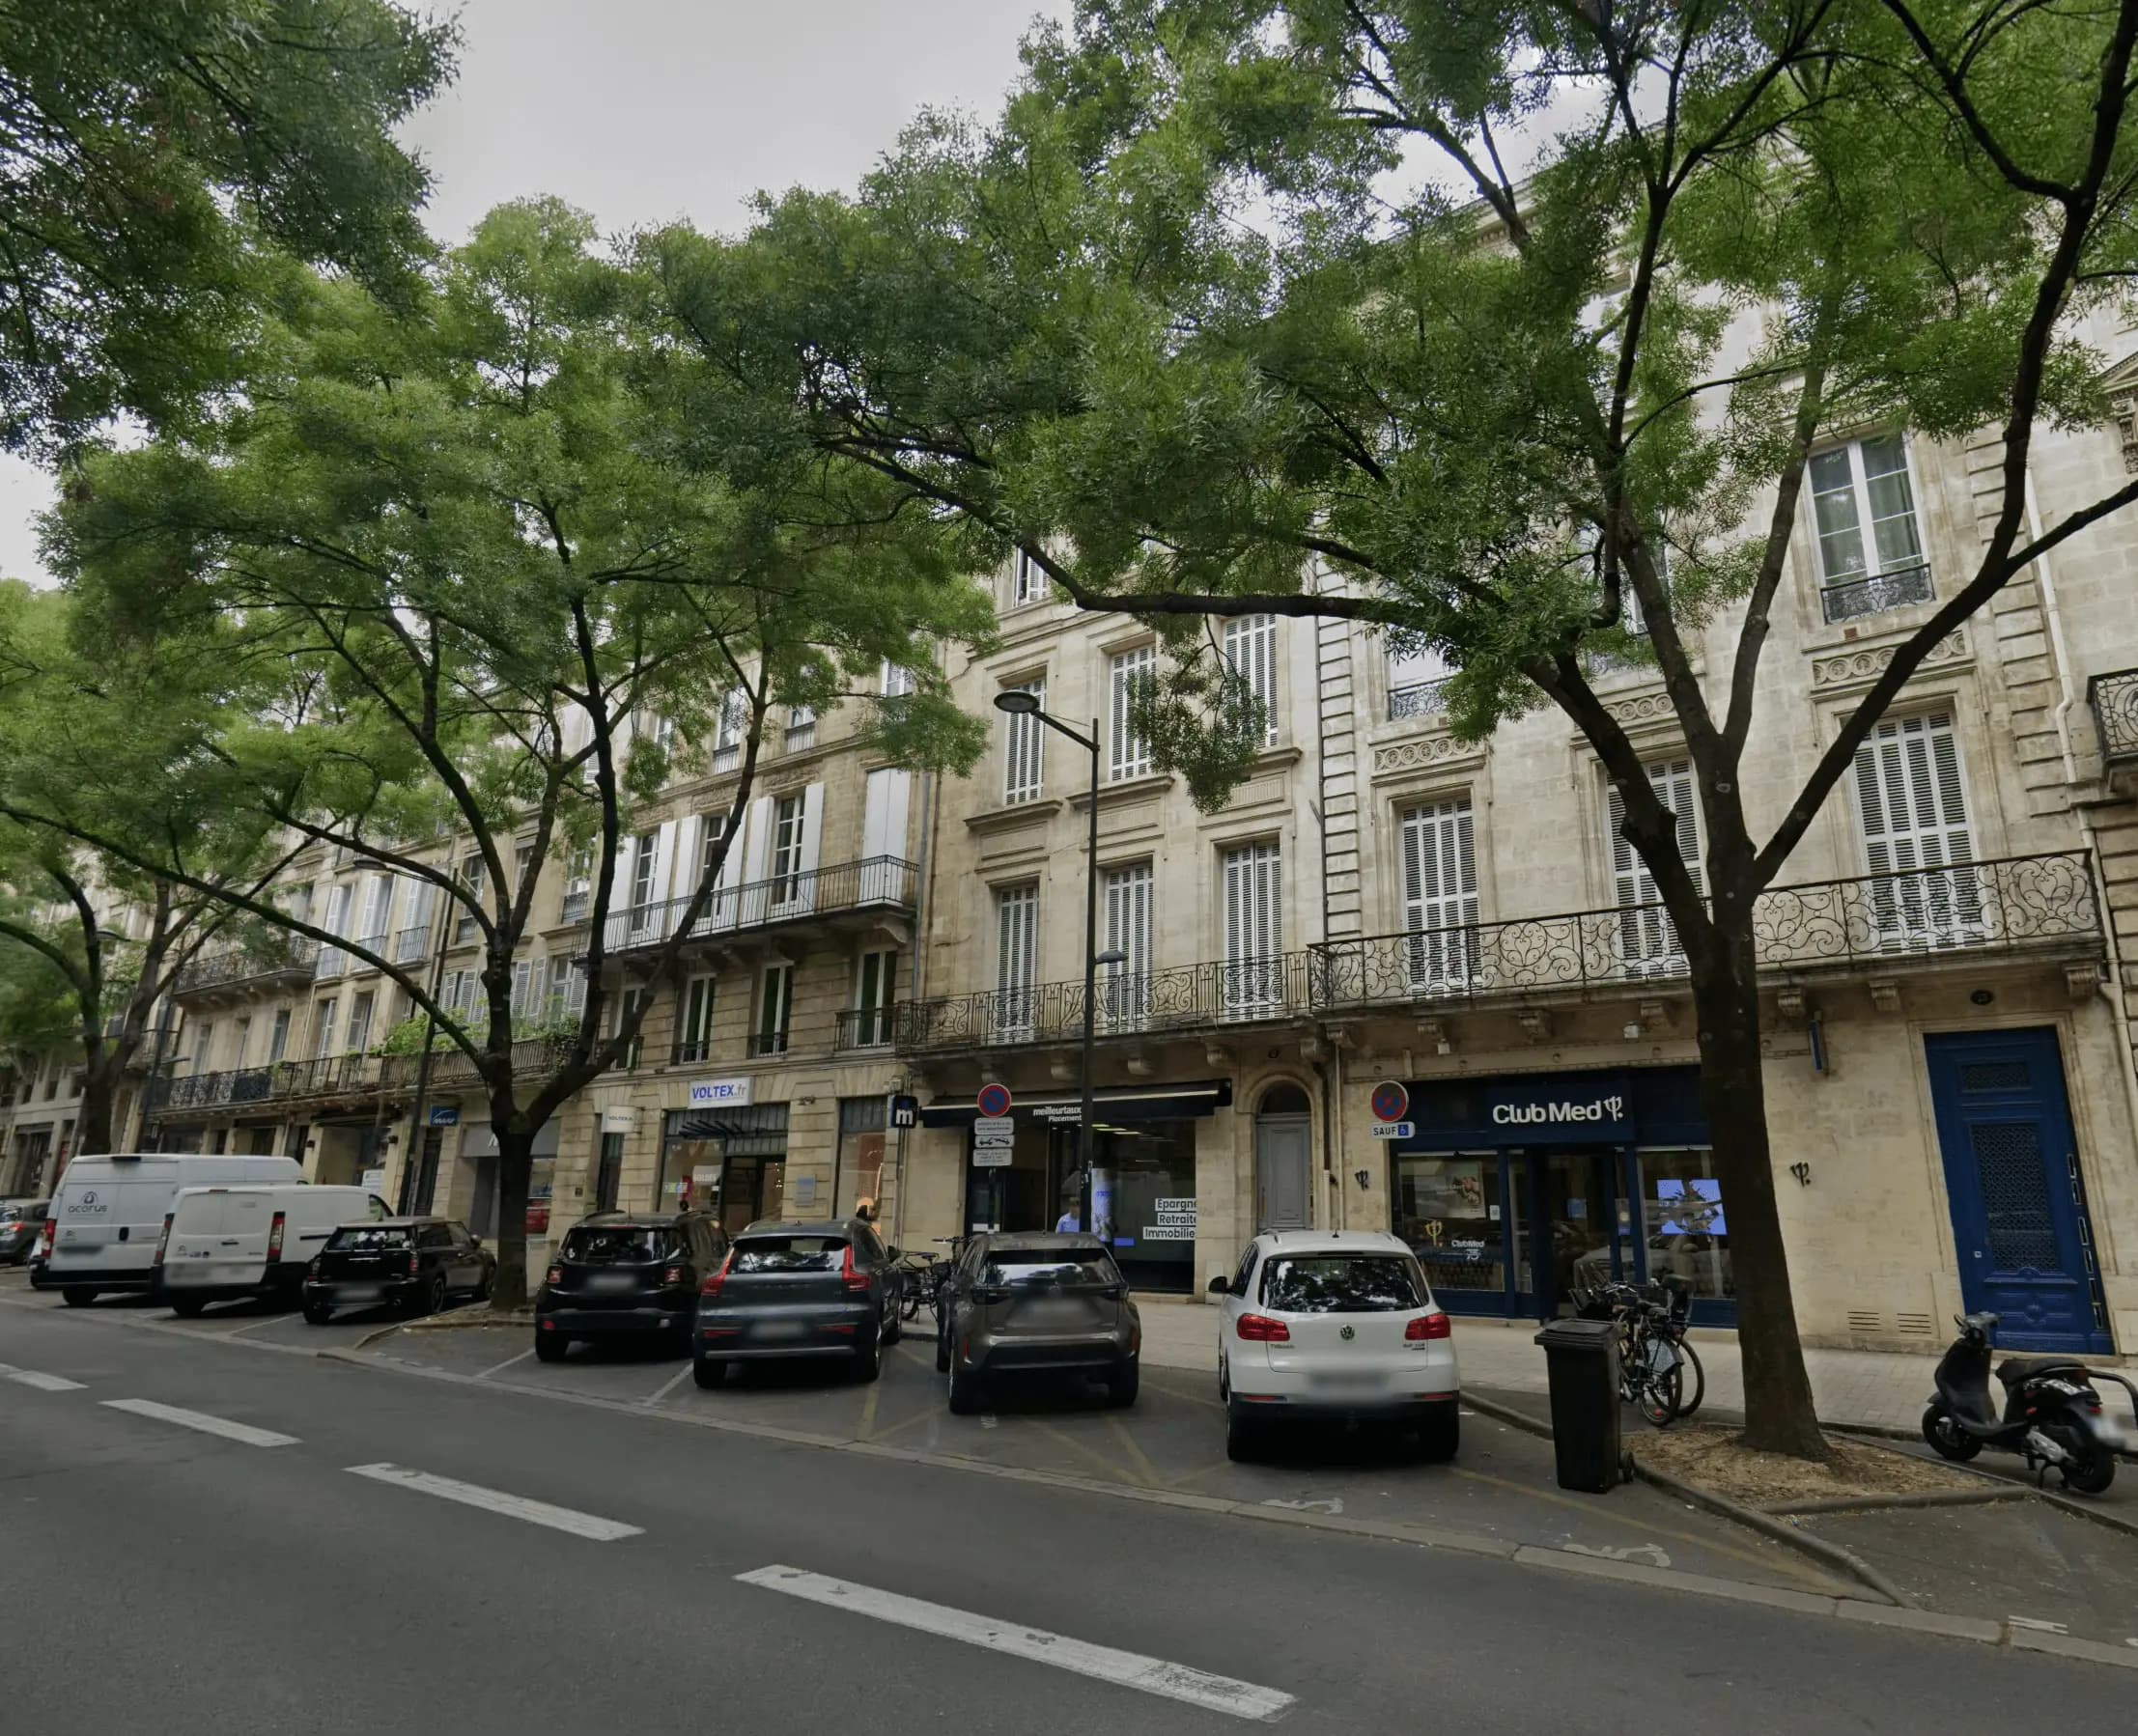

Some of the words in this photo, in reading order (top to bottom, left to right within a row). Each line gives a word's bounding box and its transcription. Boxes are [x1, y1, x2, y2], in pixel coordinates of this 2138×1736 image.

[692, 1084, 746, 1099] VOLTEX.fr
[1033, 1106, 1082, 1116] meilleurtaux
[1492, 1104, 1545, 1124] Club
[1548, 1101, 1602, 1122] Med
[1373, 1127, 1396, 1135] SAUF
[68, 1205, 107, 1214] acorus
